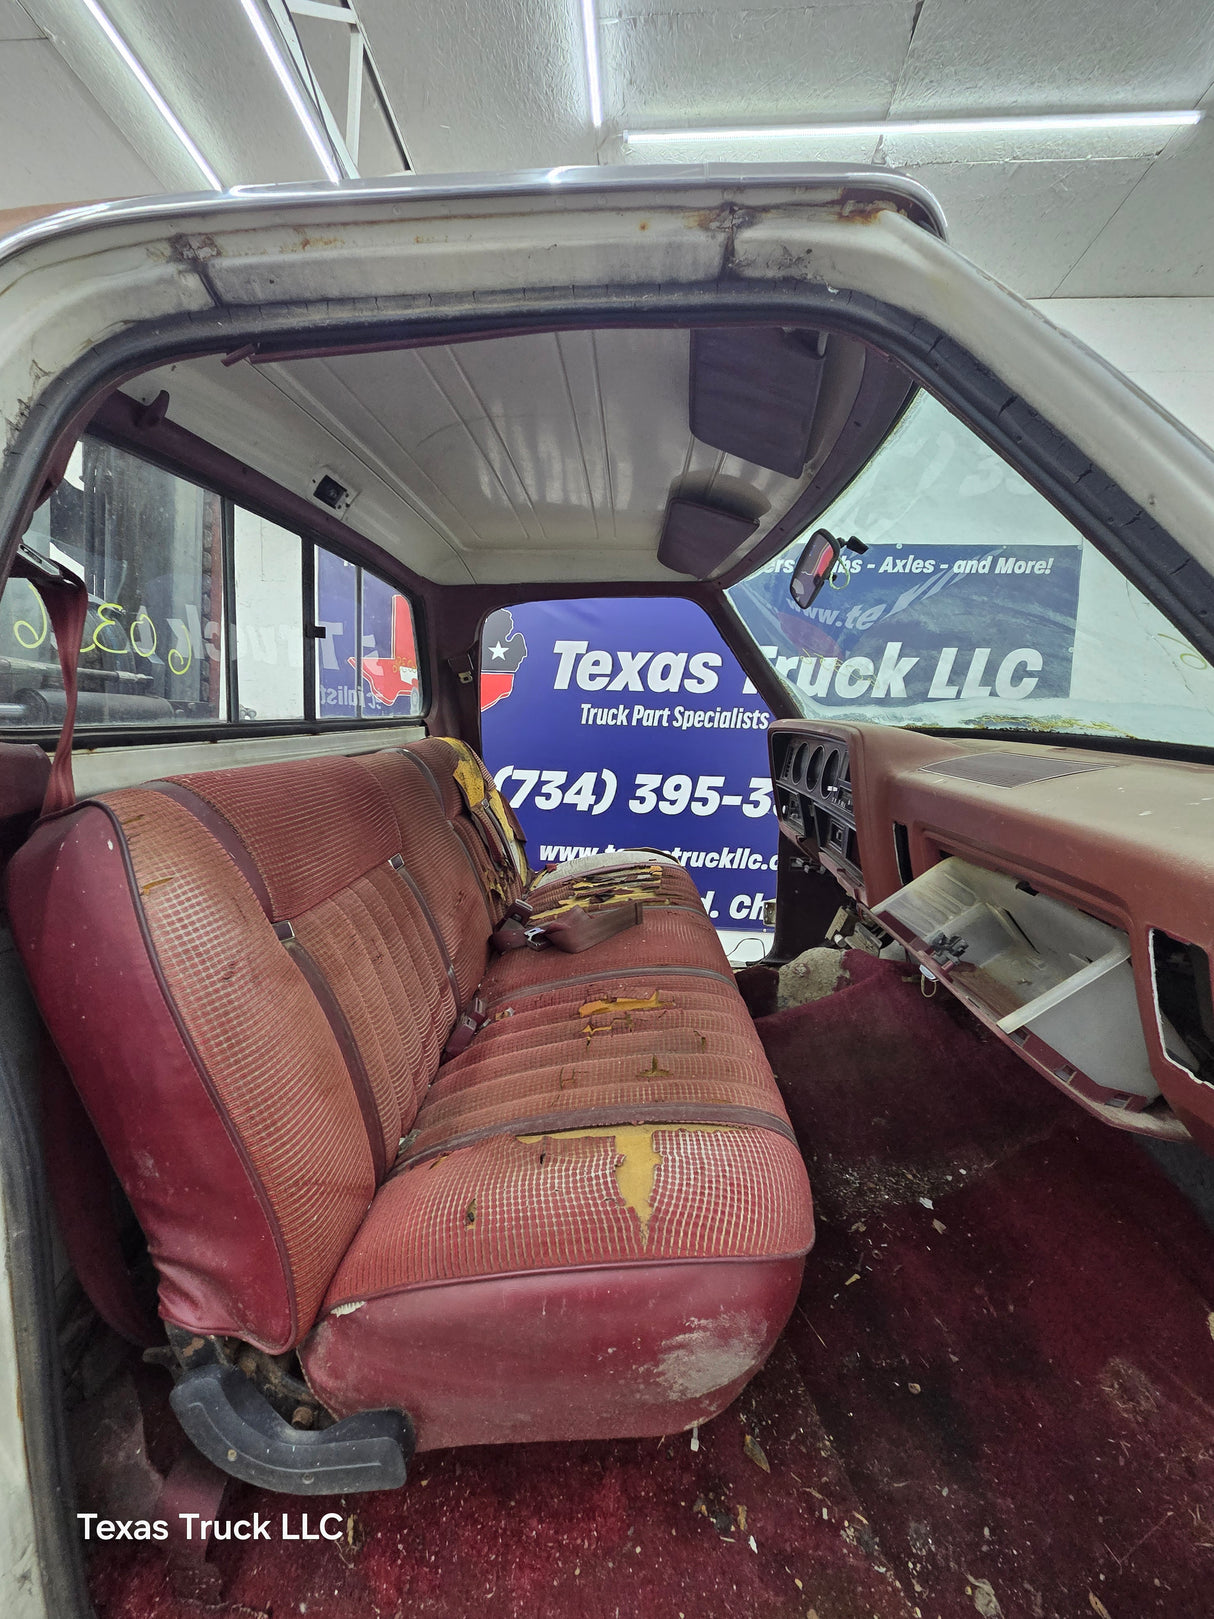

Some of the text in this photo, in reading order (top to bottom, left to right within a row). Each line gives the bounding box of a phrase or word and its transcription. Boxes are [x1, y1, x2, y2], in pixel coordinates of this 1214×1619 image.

[878, 555, 936, 574] Axles
[953, 556, 994, 574] and
[995, 557, 1054, 575] More!
[553, 639, 724, 695] Texas
[928, 647, 1043, 700] LLC
[580, 703, 770, 731] Truck Part Specialists
[493, 765, 784, 819] (734) 395-3
